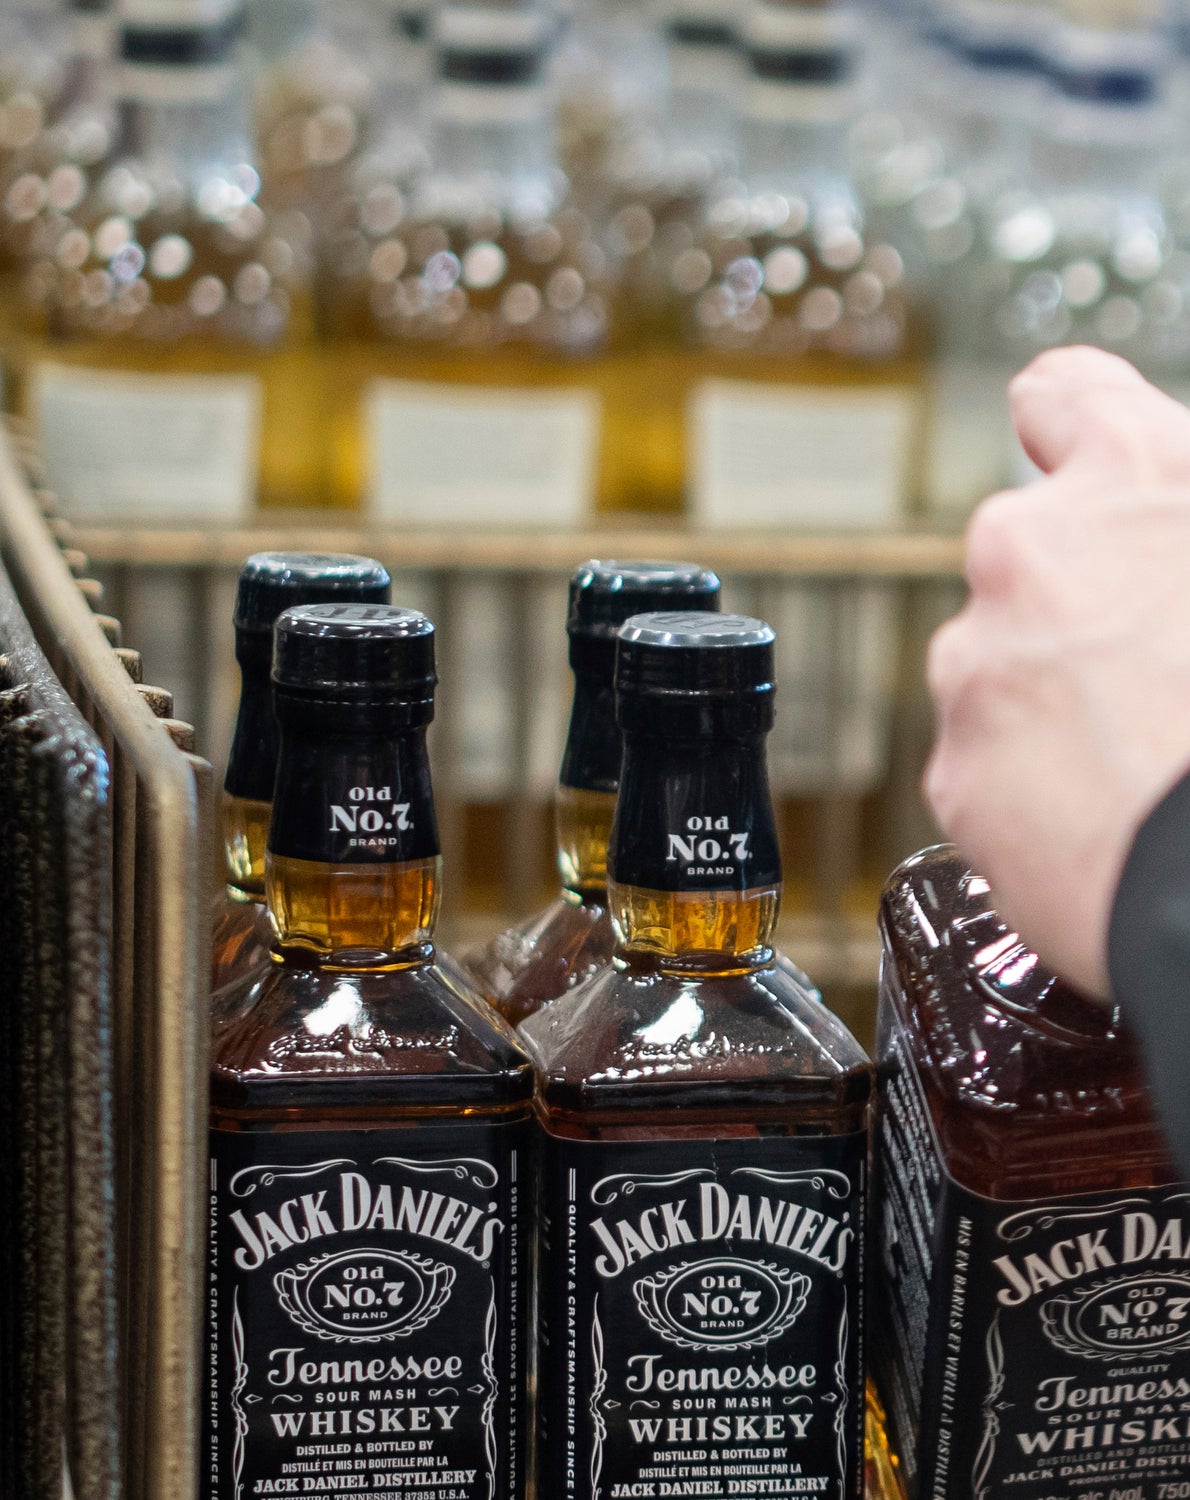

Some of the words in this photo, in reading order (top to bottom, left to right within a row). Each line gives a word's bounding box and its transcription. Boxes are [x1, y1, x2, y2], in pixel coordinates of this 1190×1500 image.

[349, 786, 392, 800] Old
[687, 816, 730, 830] Old
[350, 838, 398, 846] BRAND
[687, 867, 734, 875] BRAND
[229, 1186, 339, 1271] JACK
[339, 1172, 505, 1263] DANIEL'S
[589, 1193, 697, 1278] JACK
[700, 1182, 854, 1273] DANIEL'S
[568, 1204, 576, 1275] QUALITY
[958, 1216, 973, 1246] MIS
[510, 1223, 518, 1275] DEPUIS
[955, 1249, 970, 1271] EN
[992, 1228, 1113, 1306] JACK
[343, 1266, 384, 1280] Old
[568, 1281, 575, 1291] &
[701, 1275, 741, 1289] Old
[1127, 1286, 1165, 1300] OLD
[949, 1275, 967, 1330] BARILS
[343, 1311, 388, 1320] BRAND
[701, 1320, 744, 1328] BRAND
[1106, 1323, 1179, 1340] BRAND
[946, 1332, 961, 1353] ET
[269, 1348, 462, 1387] Tennessee
[567, 1296, 576, 1435] CRAFTSMANSHIP
[626, 1354, 816, 1392] Tennessee
[1107, 1364, 1170, 1377] QUALITY
[315, 1390, 361, 1404] SOUR
[369, 1388, 416, 1401] MASH
[509, 1384, 516, 1402] LE
[673, 1399, 717, 1410] SOUR
[725, 1397, 771, 1408] MASH
[271, 1405, 460, 1437] WHISKEY
[509, 1406, 516, 1423] ET
[1048, 1409, 1121, 1425] SOUR
[629, 1414, 813, 1443] WHISKEY
[297, 1444, 351, 1456] DISTILLED
[355, 1443, 363, 1453] &
[366, 1441, 416, 1454] BOTTLED
[419, 1440, 433, 1451] BY
[653, 1450, 706, 1461] DISTILLED
[710, 1450, 719, 1459] &
[721, 1448, 770, 1460] BOTTLED
[773, 1448, 787, 1458] BY
[282, 1459, 319, 1473] DISTILLÉ
[321, 1460, 333, 1471] ET
[335, 1459, 353, 1470] MIS
[355, 1459, 366, 1469] EN
[368, 1457, 415, 1469] BOUTEILLE
[417, 1457, 434, 1467] PAR
[436, 1456, 448, 1466] LA
[1037, 1452, 1100, 1467] DISTILLED
[1107, 1448, 1133, 1458] AND
[639, 1464, 676, 1478] DISTILLÉ
[678, 1466, 689, 1477] ET
[692, 1465, 708, 1476] MIS
[710, 1465, 721, 1475] EN
[724, 1463, 769, 1475] BOUTEILLE
[771, 1464, 788, 1474] PAR
[790, 1463, 801, 1473] LA
[1003, 1469, 1054, 1484] JACK
[1060, 1460, 1129, 1476] DANIEL
[1068, 1472, 1125, 1485] PRODUCT
[253, 1477, 299, 1493] JACK
[303, 1474, 368, 1492] DANIEL
[373, 1470, 477, 1488] DISTILLERY
[611, 1483, 655, 1497] JACK
[659, 1480, 724, 1496] DANIEL
[728, 1476, 830, 1494] DISTILLERY
[439, 1490, 469, 1500] U.S.A.
